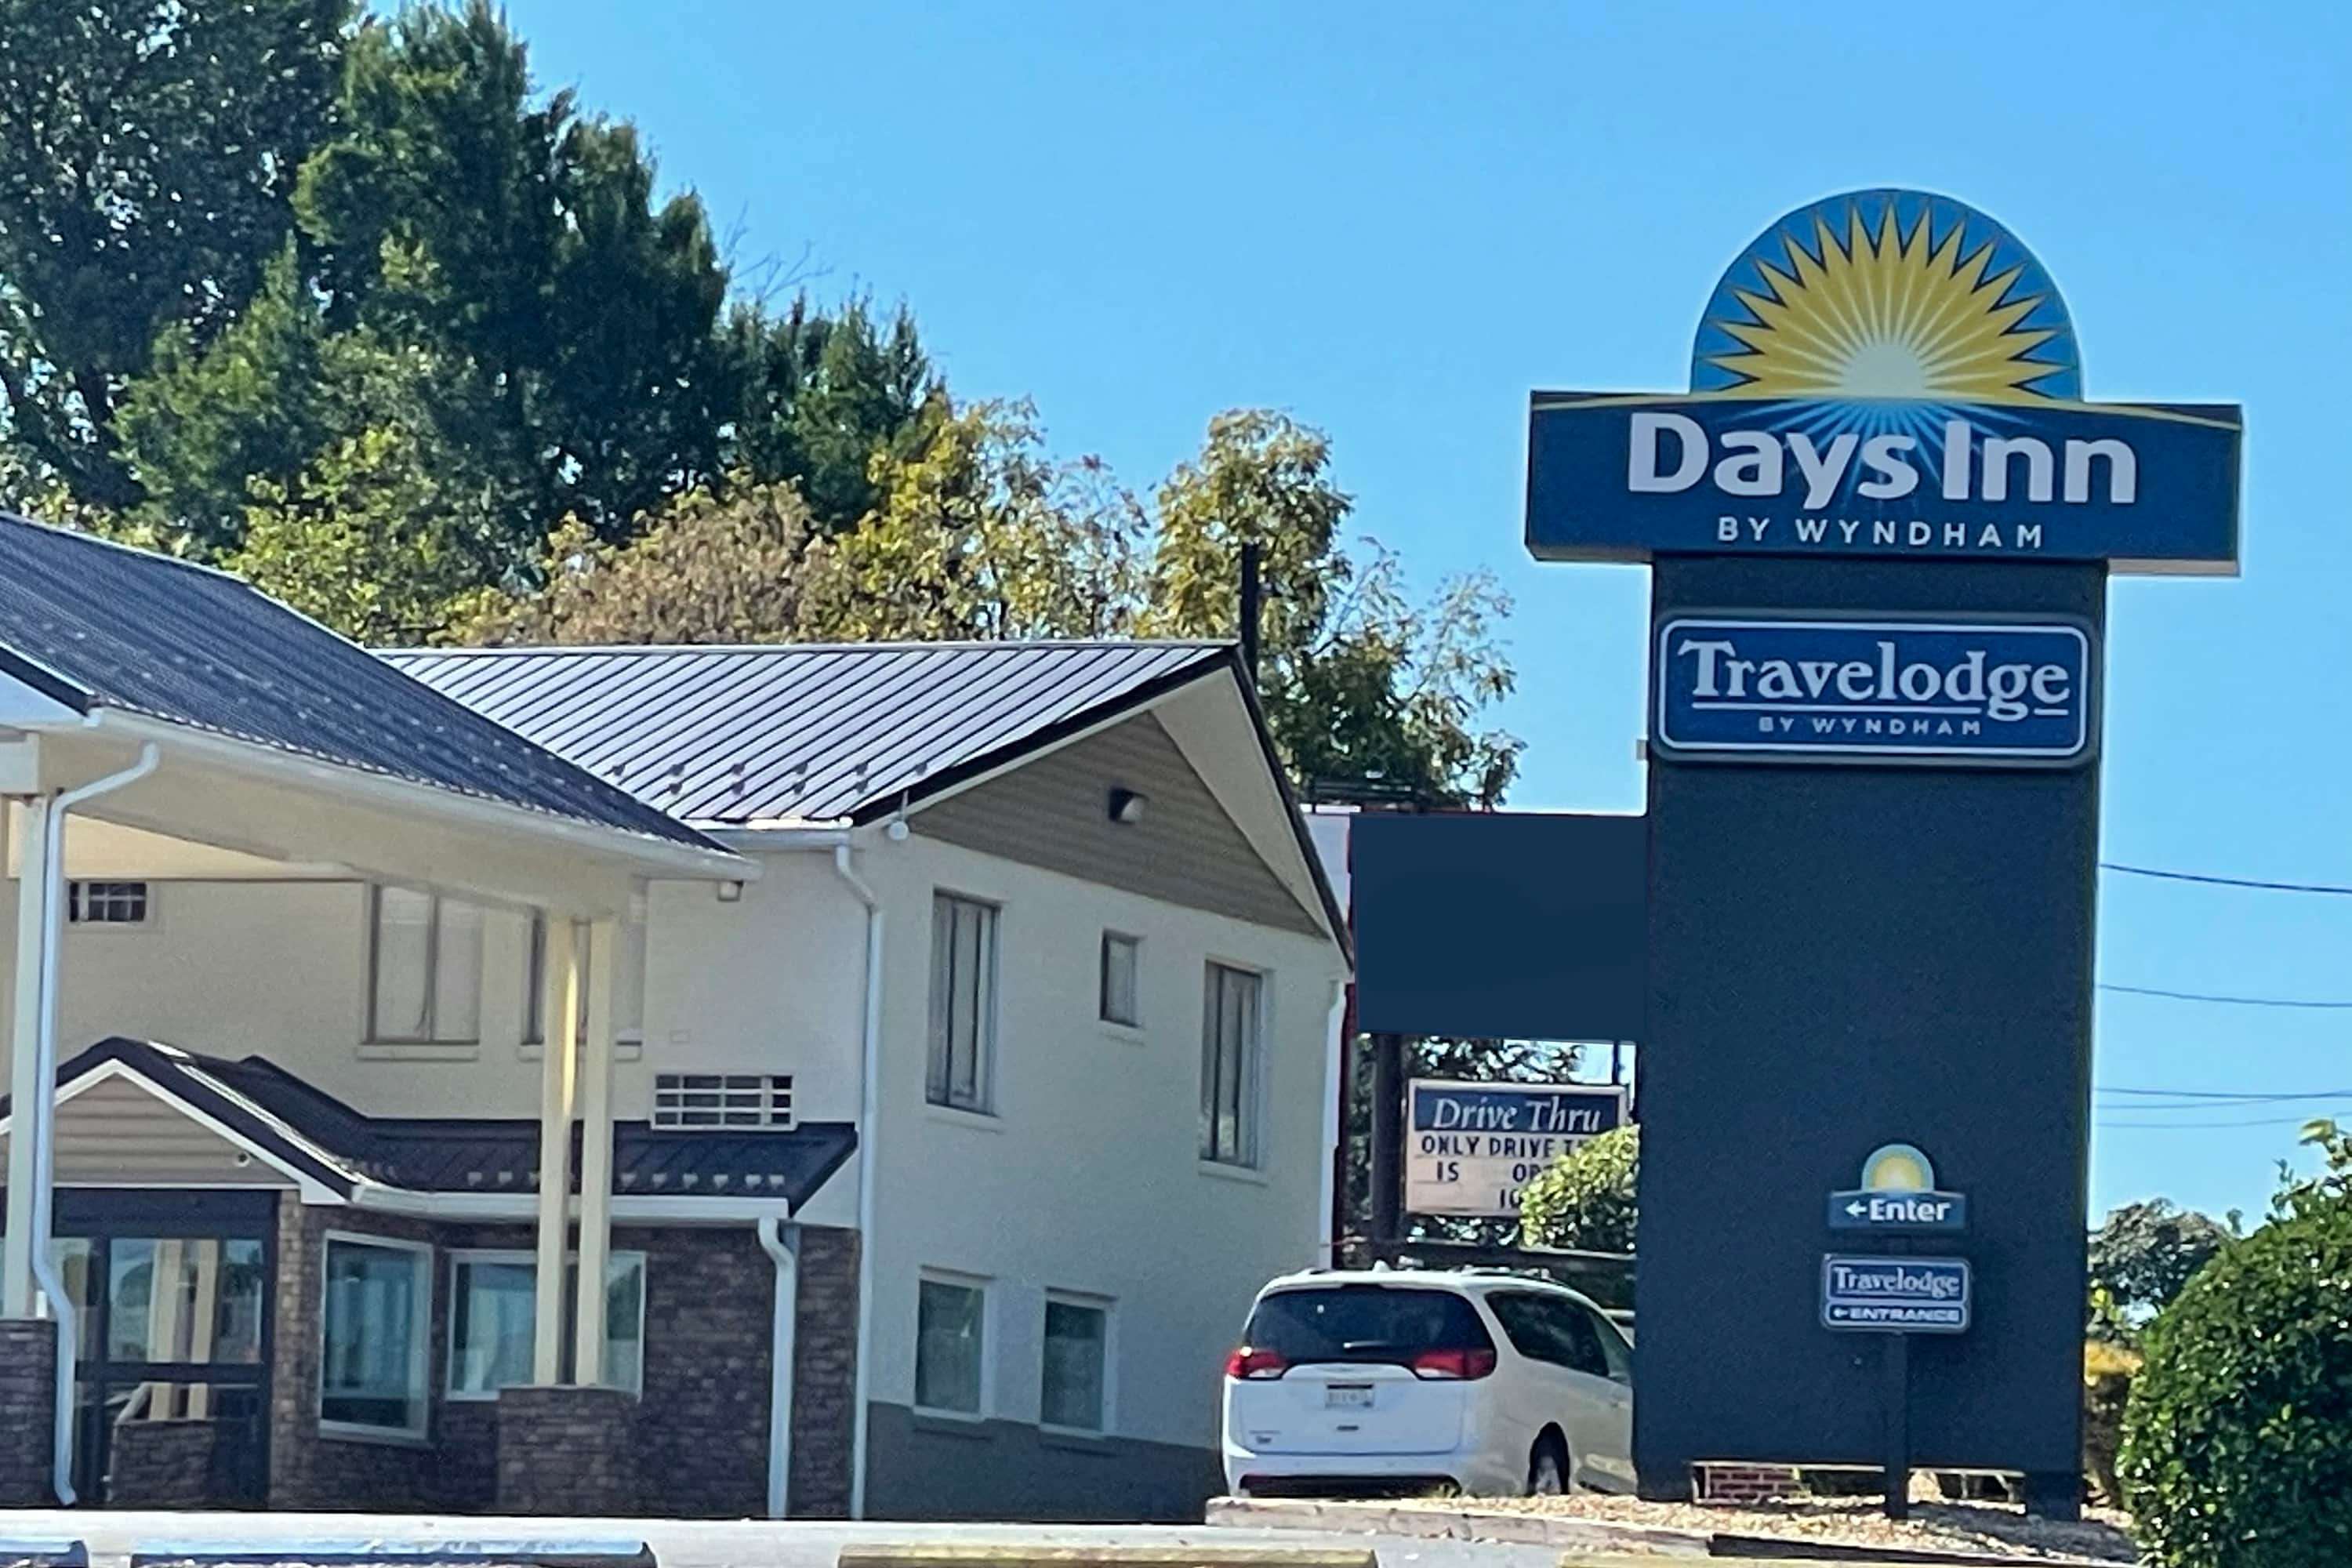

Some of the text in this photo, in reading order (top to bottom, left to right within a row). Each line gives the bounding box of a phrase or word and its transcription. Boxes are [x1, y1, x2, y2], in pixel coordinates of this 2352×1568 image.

[1628, 412, 2136, 510] Days Inn
[1719, 517, 2043, 549] BY WYNDHAM
[1677, 639, 2071, 722] Travelodge
[1759, 715, 1982, 736] BY WYNDHAM
[1432, 1094, 1602, 1133] Drive Thru
[1488, 1136, 1556, 1159] DRIVE
[1436, 1160, 1460, 1183] IS
[1869, 1198, 1951, 1222] Enter
[1832, 1266, 1960, 1299] Travelodge
[1849, 1308, 1960, 1322] ENTRANCE
